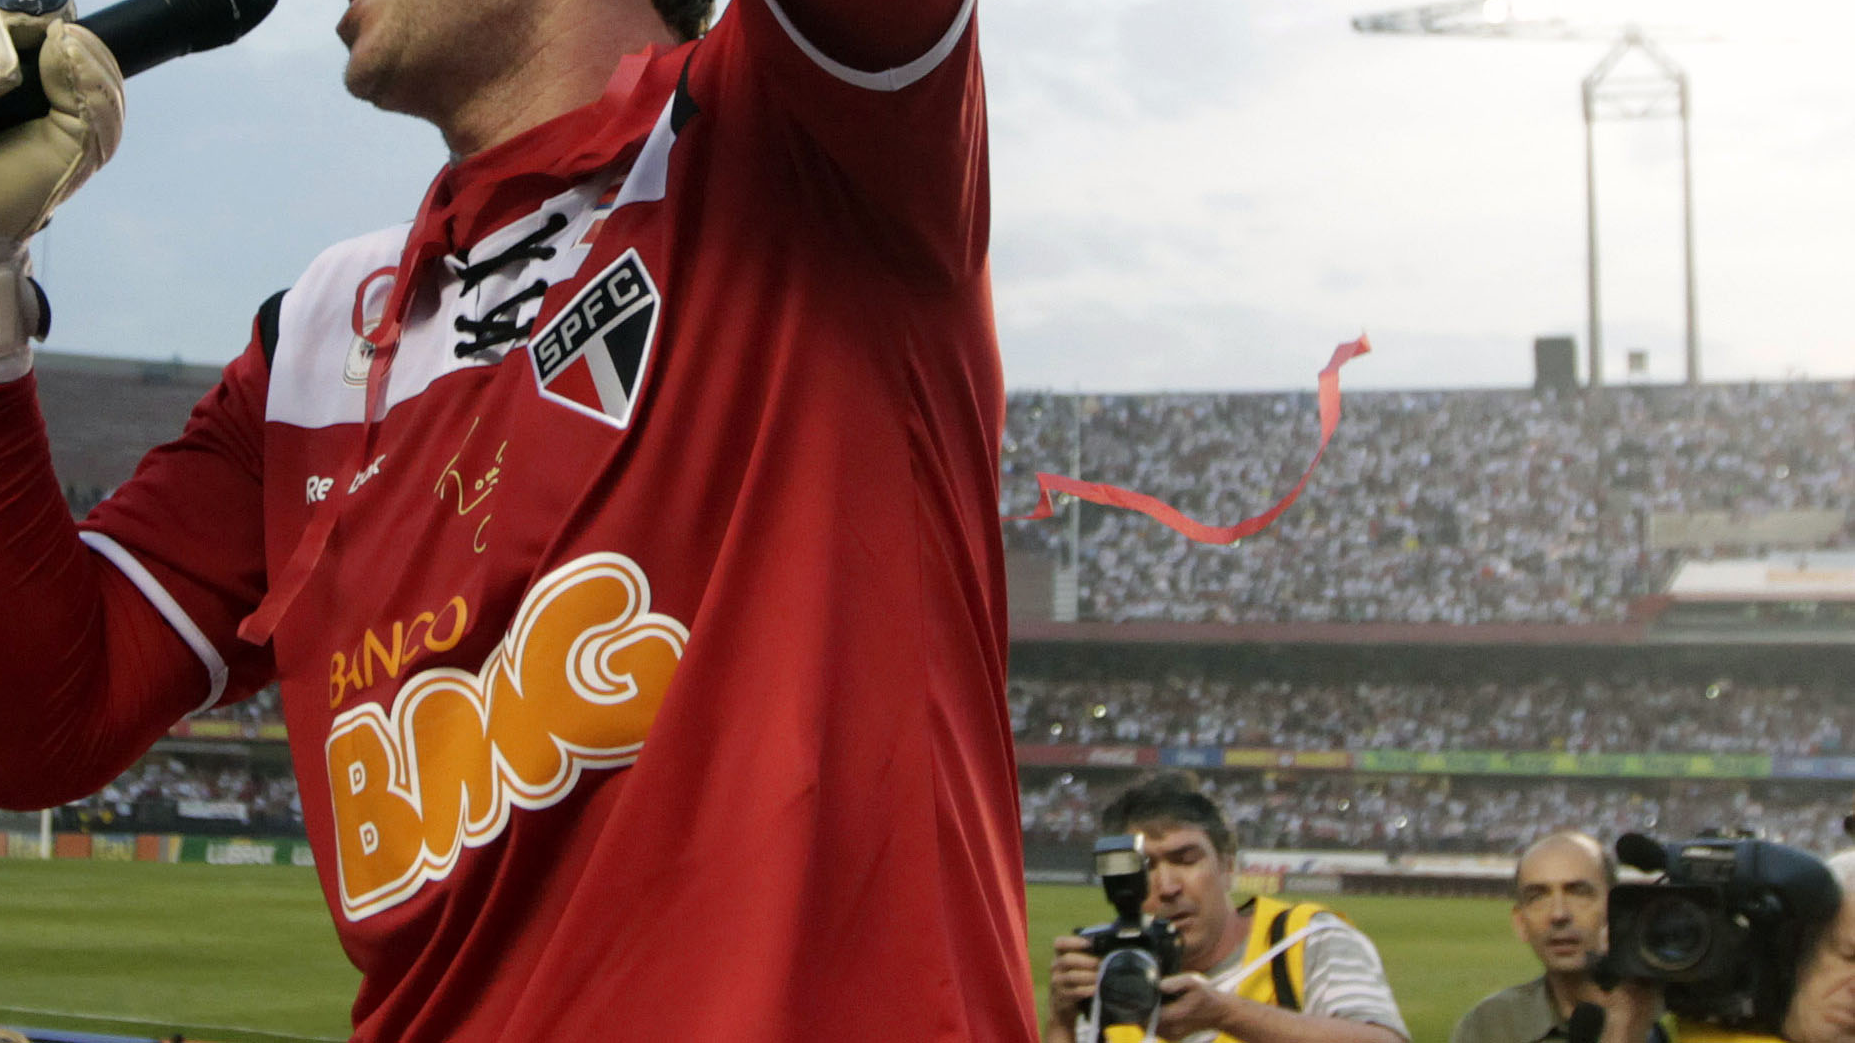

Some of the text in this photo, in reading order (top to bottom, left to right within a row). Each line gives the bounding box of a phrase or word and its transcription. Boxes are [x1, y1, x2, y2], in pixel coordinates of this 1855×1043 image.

[537, 267, 641, 373] SPFC
[306, 454, 387, 505] Rebok
[329, 595, 468, 710] BANCO
[324, 551, 690, 922] BMG
